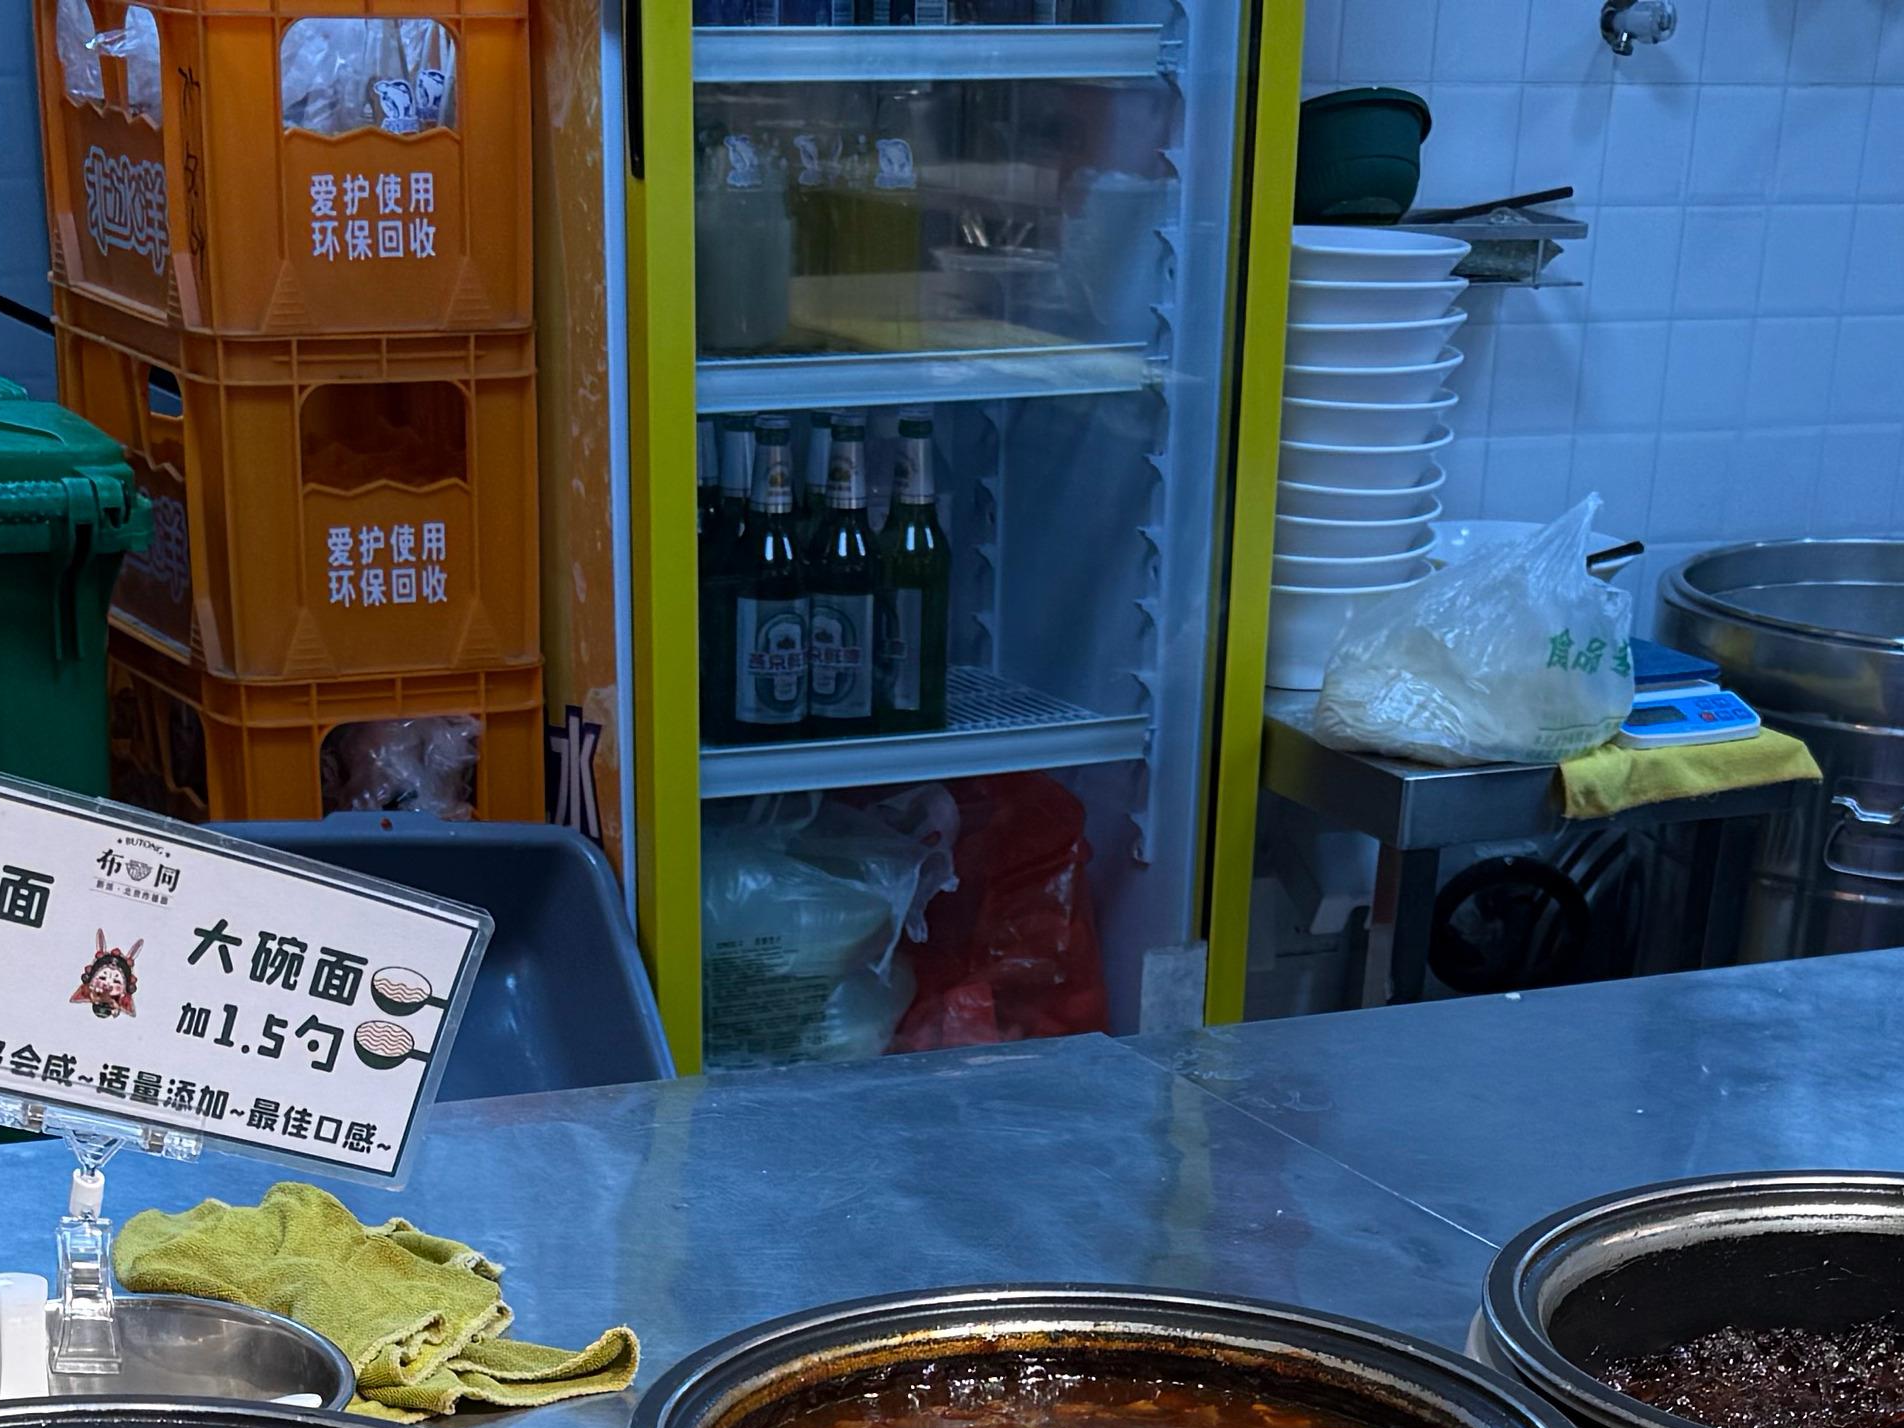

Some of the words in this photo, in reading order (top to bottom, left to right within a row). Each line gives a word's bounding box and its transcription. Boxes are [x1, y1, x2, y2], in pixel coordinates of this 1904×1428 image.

[309, 171, 435, 216] 爱护使用
[310, 218, 437, 261] 环保回收
[326, 521, 447, 567] 爱护使用
[327, 567, 448, 609] 环保回收
[126, 837, 165, 855] BUTONG
[188, 919, 369, 1007] 大碗面
[176, 1002, 344, 1074] 加1.5勺
